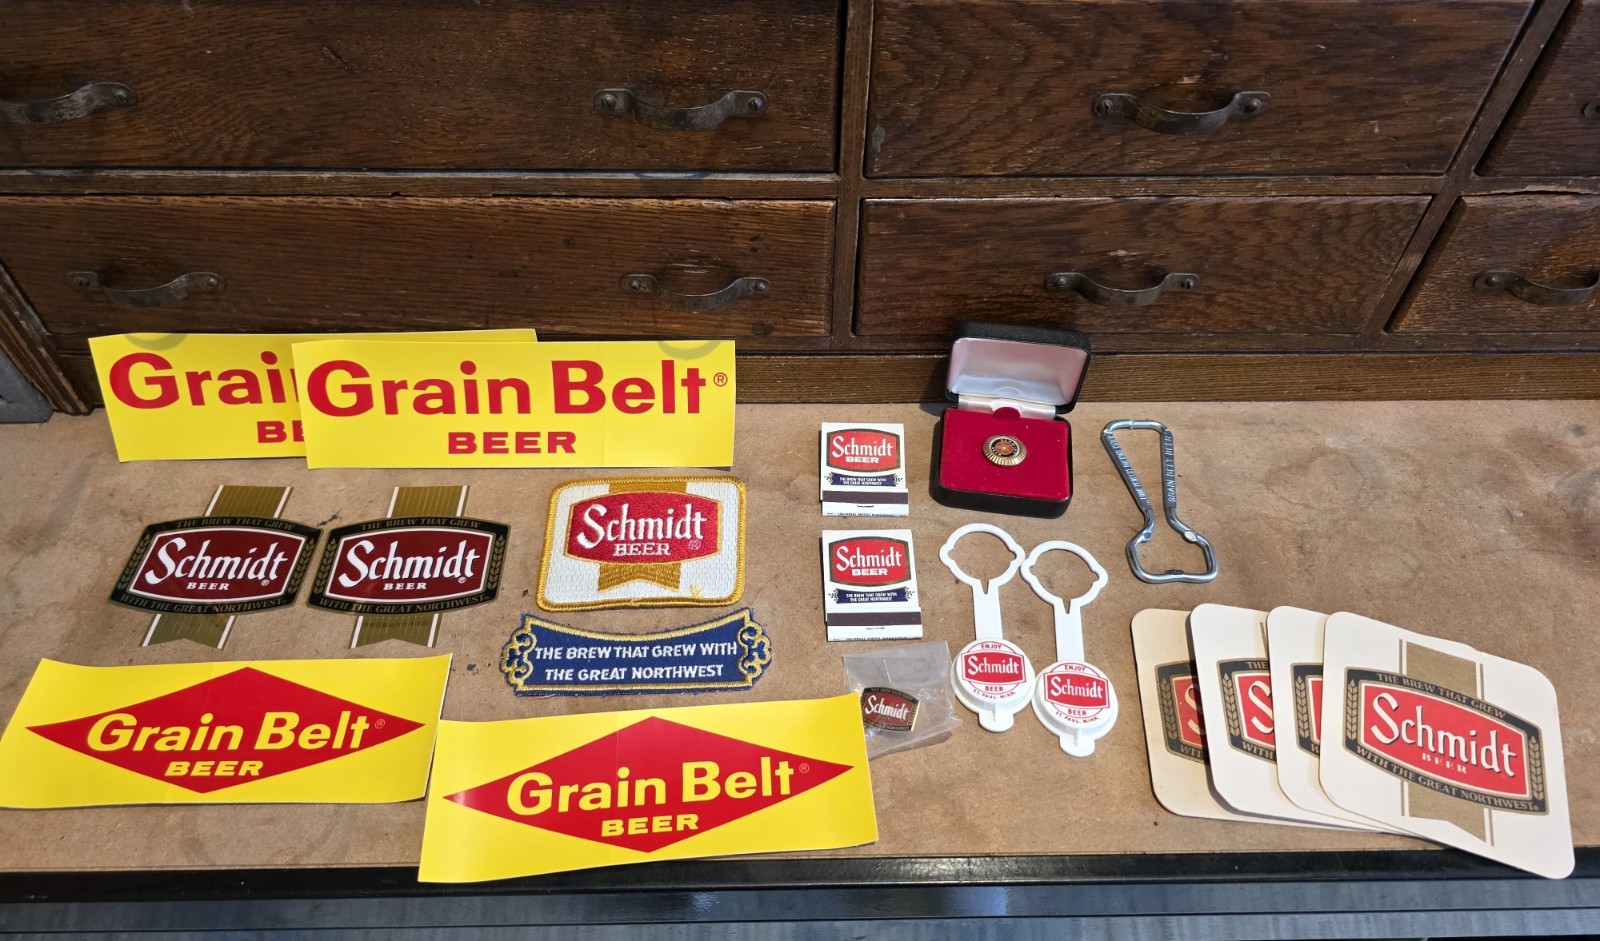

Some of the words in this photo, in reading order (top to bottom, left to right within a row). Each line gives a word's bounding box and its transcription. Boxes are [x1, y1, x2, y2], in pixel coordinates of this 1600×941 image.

[108, 351, 299, 410] Grai
[307, 359, 531, 418] Grain
[447, 430, 577, 455] BEER
[831, 435, 894, 458] Schmidt
[845, 456, 880, 464] BEER
[176, 519, 198, 529] THE
[201, 517, 233, 526] BREW
[235, 517, 262, 526] THAT
[264, 519, 296, 531] GREW
[361, 521, 383, 531] THE
[385, 518, 417, 527] BREW
[419, 517, 446, 526] THAT
[449, 518, 481, 529] GREW
[576, 502, 708, 549] Schmidt
[144, 535, 289, 585] Schmidt
[612, 542, 671, 557] BEER
[835, 545, 903, 572] Schmidt
[337, 538, 481, 588] Schmidt
[851, 568, 888, 577] BEER
[186, 581, 230, 591] BEER
[382, 582, 427, 591] BEER
[120, 593, 148, 608] WITH
[149, 600, 171, 612] THE
[172, 601, 209, 613] GREAT
[211, 597, 284, 613] NORTHWEST
[318, 597, 349, 610] WITH
[350, 601, 373, 613] THE
[375, 603, 413, 614] GREAT
[415, 593, 486, 613] NORTHWEST
[535, 646, 563, 661] THE
[565, 646, 613, 660] BREW
[613, 645, 650, 659] THAT
[651, 643, 697, 658] GREW
[699, 641, 738, 656] WITH
[545, 668, 573, 681] THE
[577, 667, 627, 681] GREAT
[631, 664, 724, 679] NORTHWEST
[967, 655, 1020, 676] Schmidt
[1064, 664, 1087, 672] ENJOY
[1245, 661, 1268, 670] THE
[1050, 675, 1104, 699] Schmidt
[1376, 672, 1400, 684] THE
[1402, 677, 1436, 693] BREW
[1438, 687, 1469, 704] THAT
[1470, 700, 1507, 719] GREW
[864, 694, 910, 720] Schmidt
[1067, 708, 1087, 716] BEER
[86, 712, 242, 752] Grain
[1370, 692, 1518, 778] Schmidt
[1179, 745, 1204, 758] WIT
[1242, 741, 1274, 760] WITH
[164, 760, 265, 777] BEER
[1356, 746, 1389, 769] WITH
[1390, 763, 1416, 781] THE
[1418, 776, 1459, 796] GREAT
[1421, 752, 1468, 775] BEER
[505, 766, 668, 816] Grain
[600, 813, 699, 838] BEER
